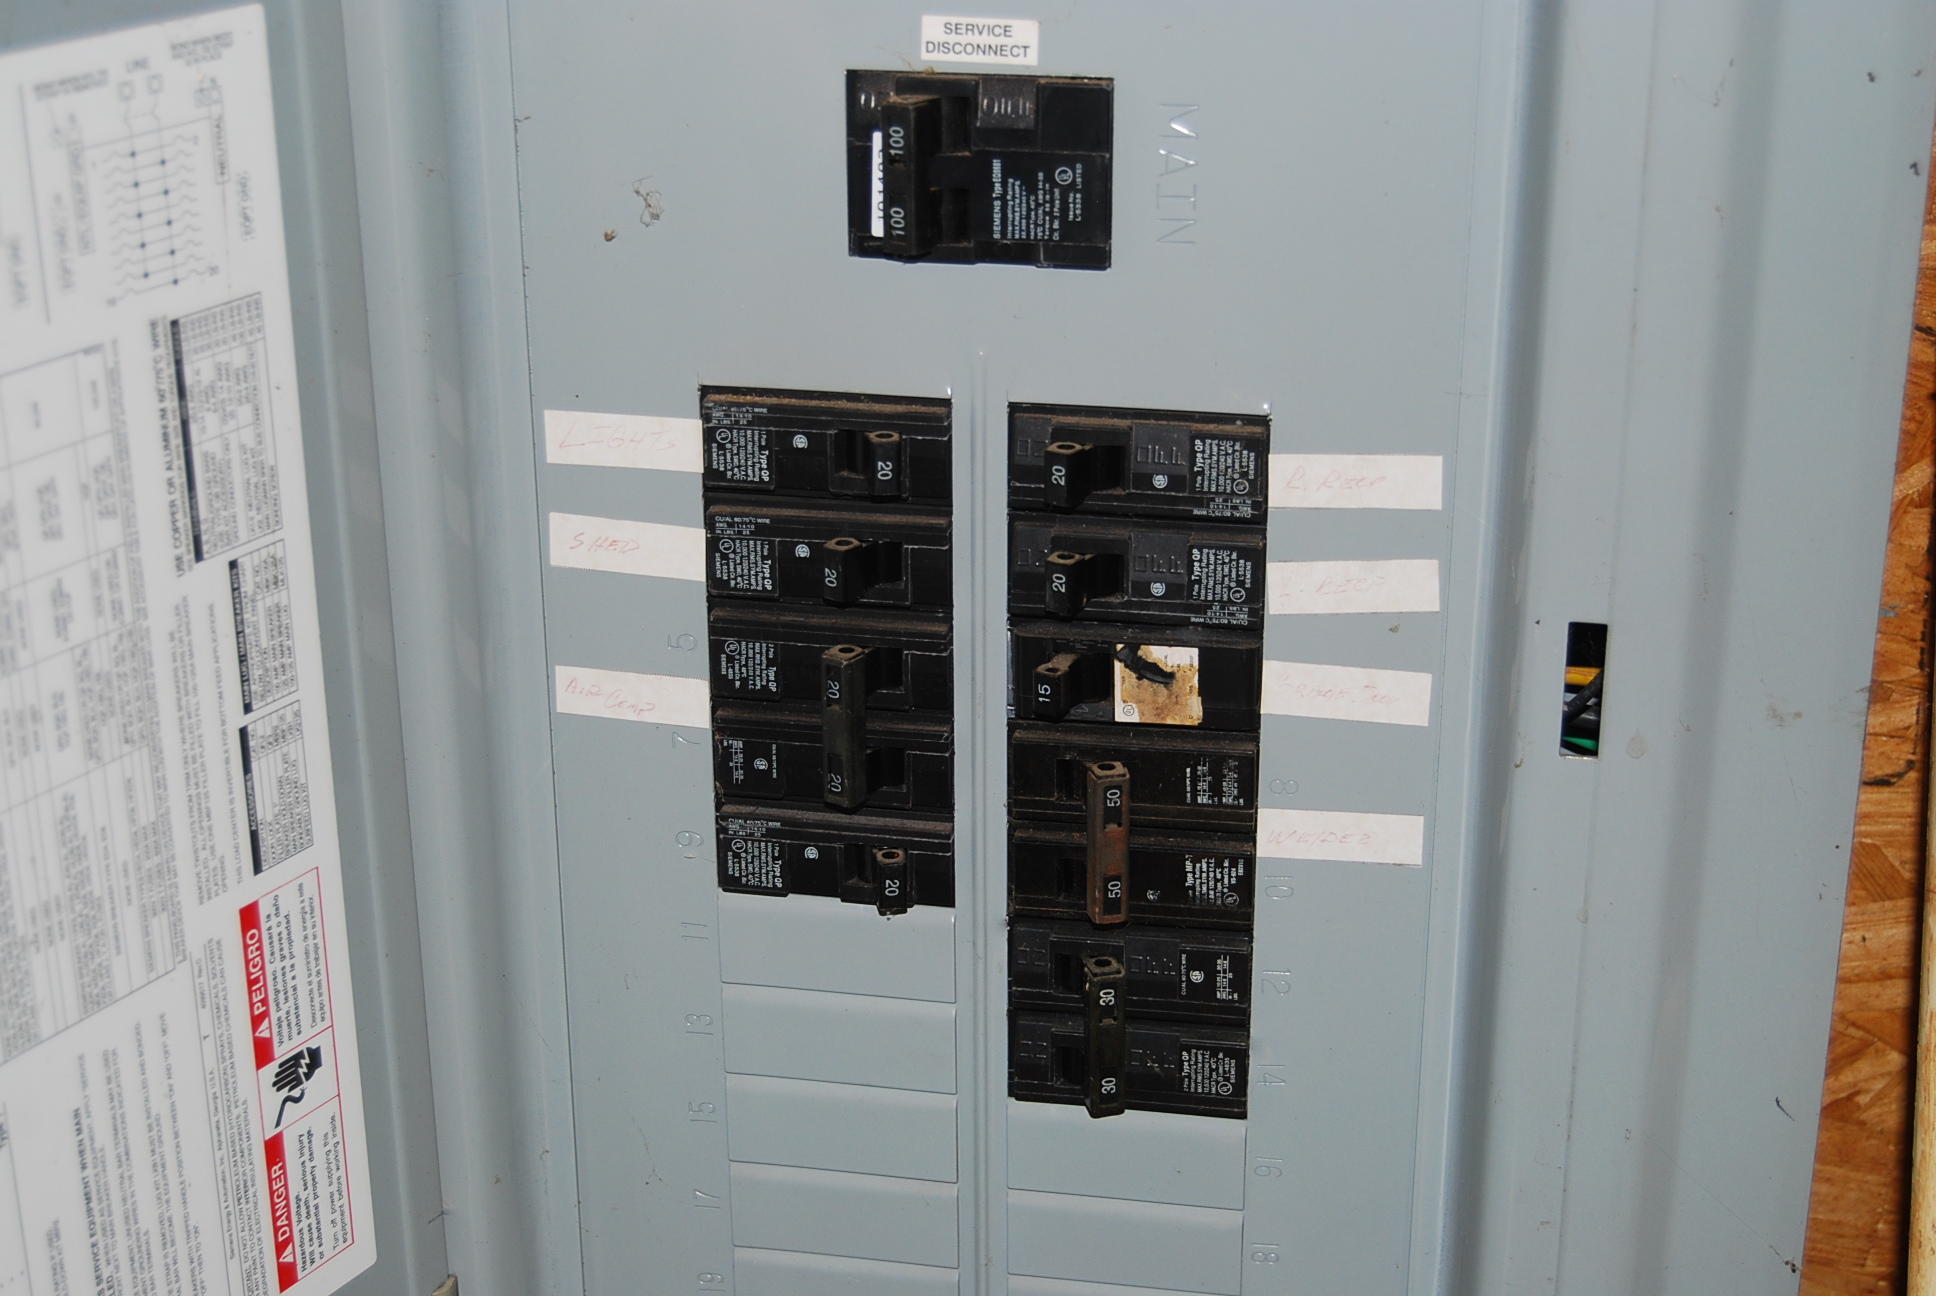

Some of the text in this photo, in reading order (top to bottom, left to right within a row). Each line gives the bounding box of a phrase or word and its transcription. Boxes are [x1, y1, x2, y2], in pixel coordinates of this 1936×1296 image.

[943, 22, 1014, 38] SERVICE
[925, 41, 1031, 58] DISCONNECT
[216, 117, 226, 176] NEUTRAL
[889, 126, 904, 158] 100
[1156, 102, 1200, 246] MAIN
[889, 206, 905, 238] 100
[992, 182, 1003, 239] SIEMENS Type
[150, 321, 159, 348] WIRE
[160, 408, 172, 470] ALUMINUM
[760, 450, 769, 481] Type QP
[1194, 440, 1203, 471] Type QP
[876, 460, 892, 481] 20
[1051, 465, 1066, 486] 20
[167, 477, 176, 494] OR
[170, 500, 181, 548] COPPER
[568, 530, 640, 553] SHED
[175, 555, 184, 576] USE
[763, 560, 772, 590] Type QP
[1192, 549, 1201, 580] Type QP
[824, 566, 838, 588] 20
[1051, 574, 1066, 593] 20
[1200, 568, 1208, 600] Interrupting
[667, 632, 698, 652] 5
[768, 667, 776, 691] Type QP
[825, 680, 840, 699] 20
[1037, 684, 1051, 702] 15
[671, 730, 701, 749] 7
[828, 773, 842, 793] 20
[1270, 778, 1299, 796] 8
[246, 773, 256, 829] ACCESSORIES
[1107, 788, 1121, 808] 50
[675, 829, 704, 849] 9
[773, 860, 782, 887] Type QP
[1186, 873, 1194, 886] Type
[884, 878, 899, 897] 20
[1107, 880, 1122, 899] 50
[1264, 874, 1296, 900] 10
[266, 914, 271, 923] la
[680, 921, 709, 941] 11
[278, 931, 286, 962] graves
[248, 929, 267, 1015] PELIGRO
[289, 963, 295, 972] la
[272, 970, 281, 1012] peligroso.
[281, 966, 289, 1004] lesiones
[1261, 967, 1292, 996] 12
[1099, 988, 1115, 1006] 30
[291, 984, 302, 1035] substancial
[276, 1016, 284, 1047] Voltaje
[285, 1006, 293, 1040] muerte,
[685, 1012, 714, 1035] 13
[1182, 1052, 1190, 1076] Type QP
[1102, 1076, 1117, 1094] 30
[1256, 1064, 1287, 1089] 14
[688, 1100, 717, 1124] 15
[325, 1149, 333, 1186] supplying
[1253, 1156, 1284, 1179] 16
[310, 1165, 319, 1200] property
[74, 1108, 103, 1286] SERVICE EQUIPMENT WHEN MAIN
[272, 1162, 289, 1242] DANGER
[694, 1188, 721, 1209] 17
[313, 1203, 323, 1247] substantial
[339, 1204, 348, 1243] equipment
[299, 1228, 307, 1272] Hazardous
[319, 1251, 324, 1259] or
[1250, 1243, 1280, 1266] 18
[698, 1271, 725, 1293] 19
